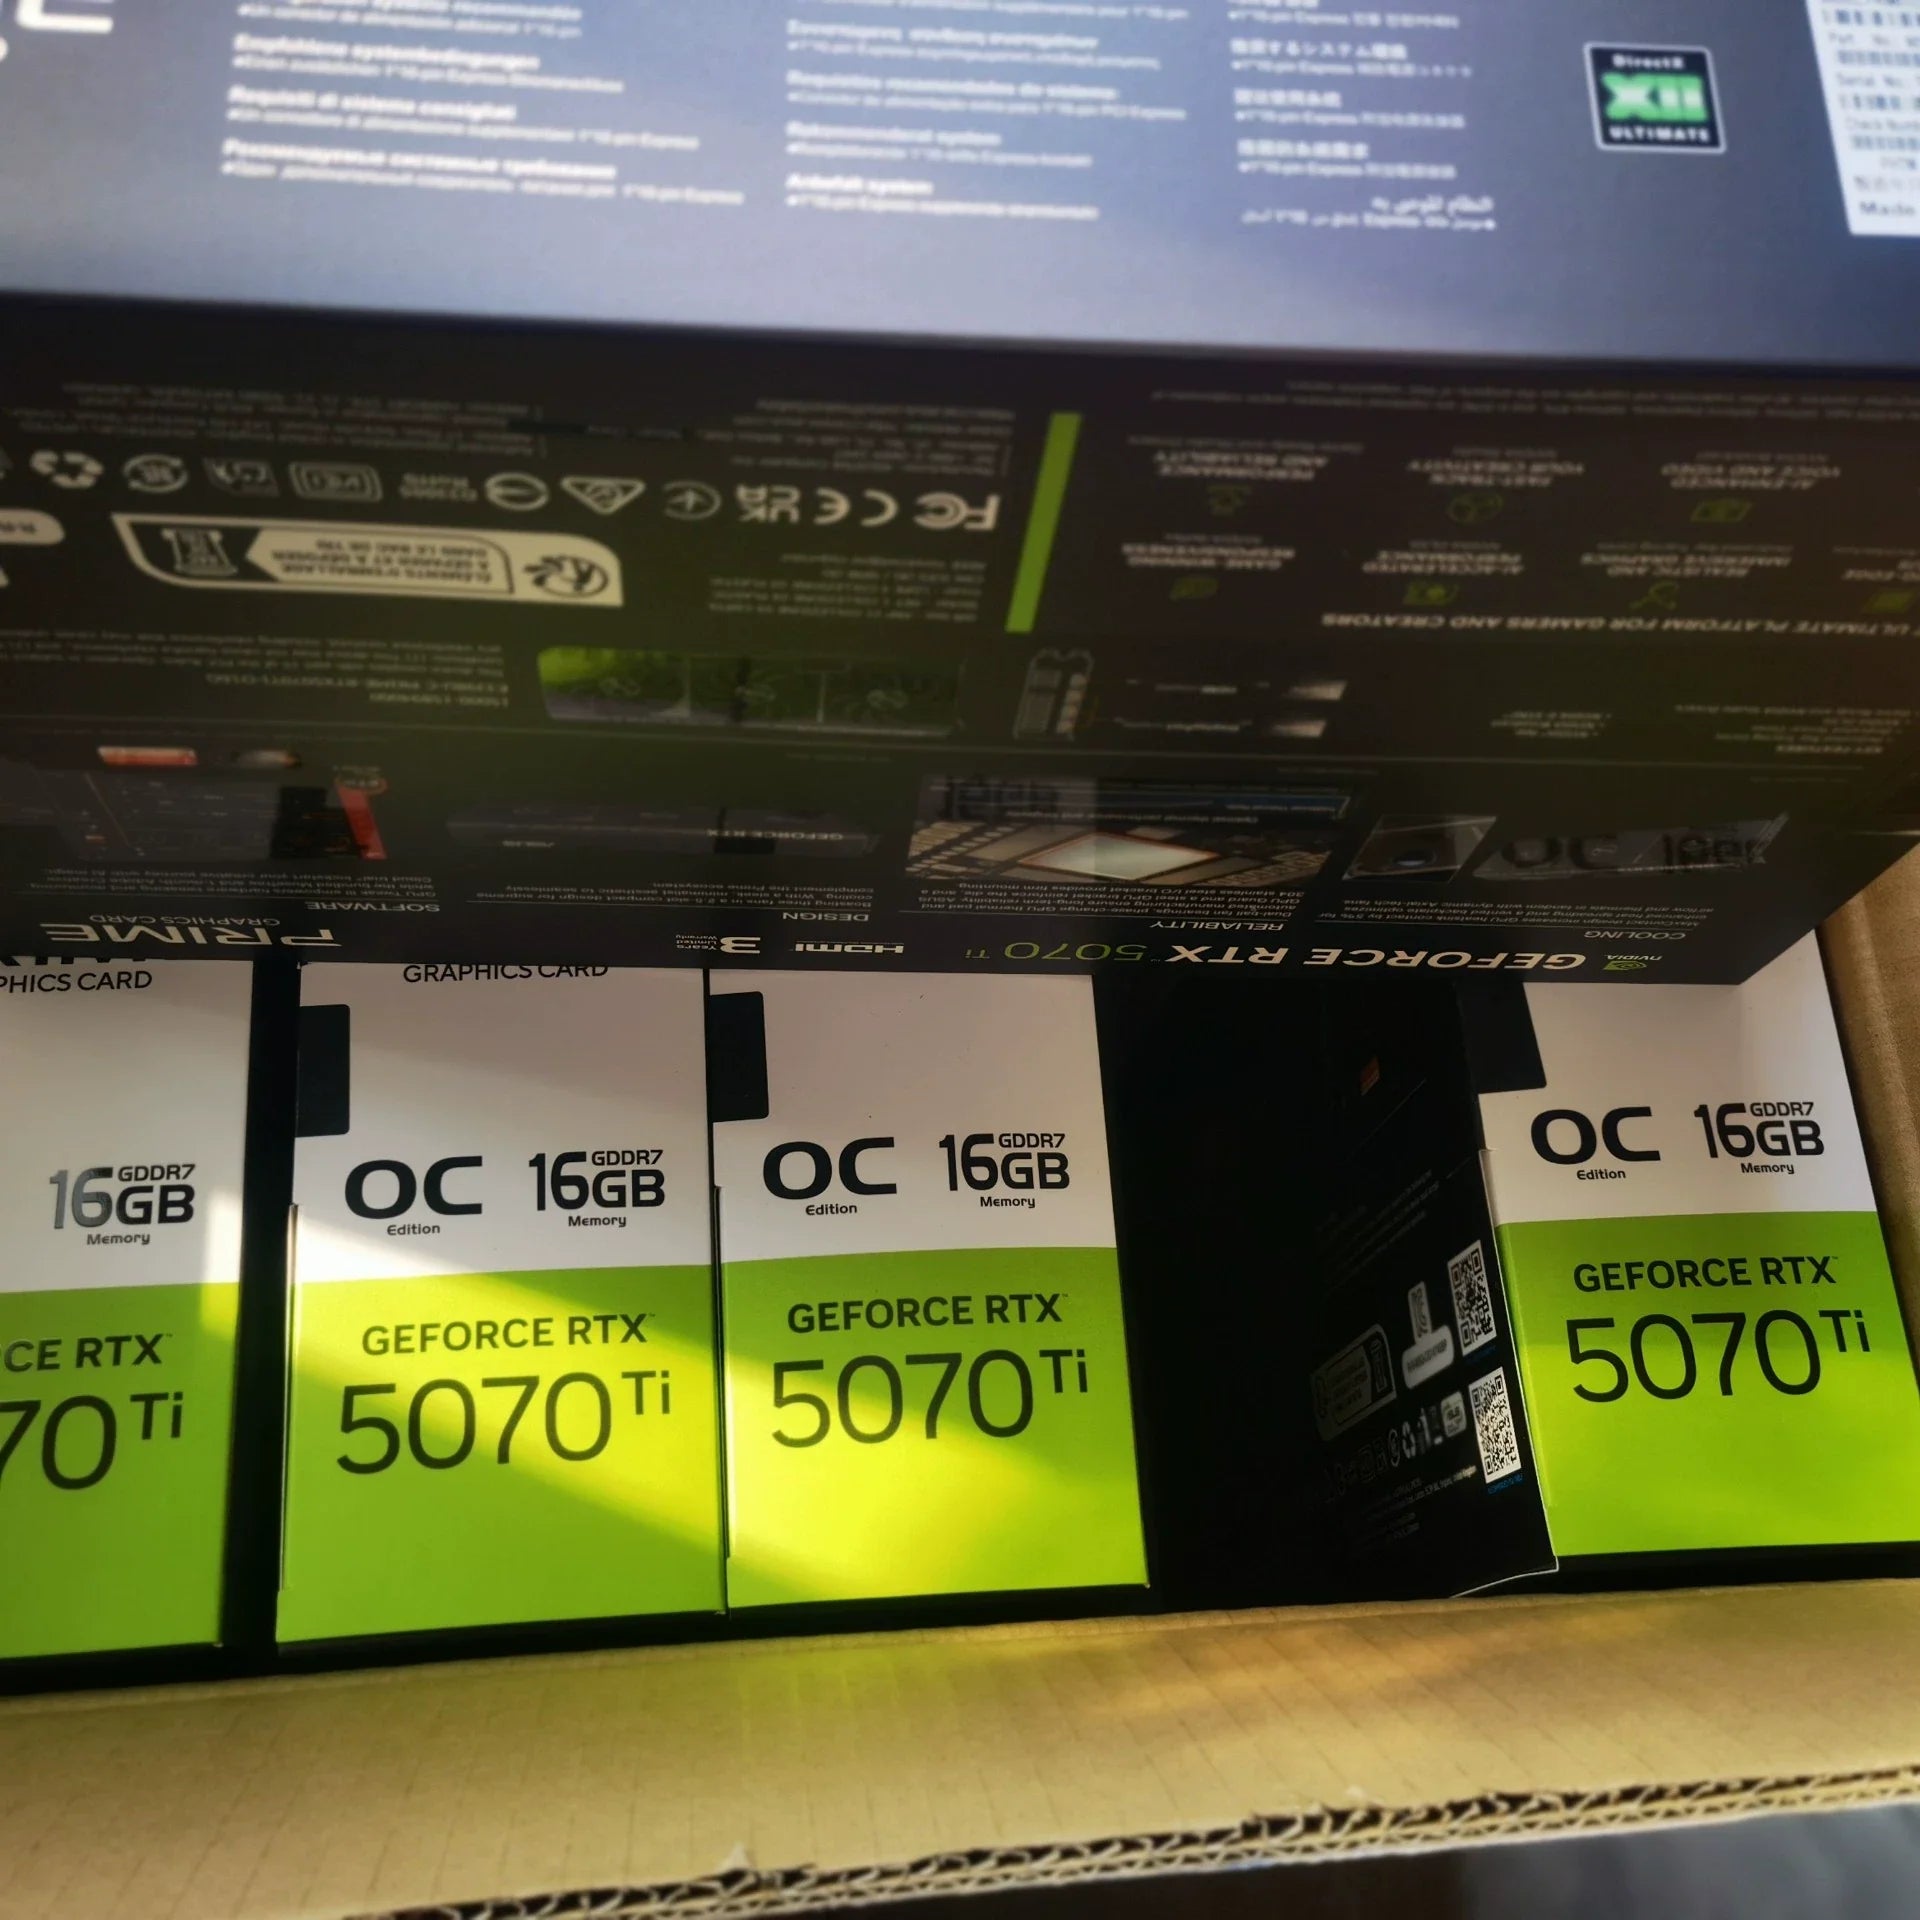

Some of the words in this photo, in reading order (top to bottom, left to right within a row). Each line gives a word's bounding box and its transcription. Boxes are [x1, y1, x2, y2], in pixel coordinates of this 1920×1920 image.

[1609, 126, 1709, 142] ULTIMATE
[1321, 613, 1445, 628] CREATORS
[1450, 615, 1502, 629] AND
[1506, 616, 1606, 631] GAMERS
[1609, 617, 1659, 631] FOR
[1662, 618, 1790, 633] PLATFORM
[1793, 621, 1910, 635] ULTIMATE
[607, 894, 663, 902] compact
[304, 901, 440, 912] SOFTWARE
[88, 914, 156, 923] CARD
[161, 915, 280, 925] GRAPHICS
[781, 912, 870, 922] DESIGN
[1149, 920, 1284, 931] RELIABILITY
[40, 923, 342, 947] PRIME
[1584, 930, 1686, 940] COOLING
[719, 936, 761, 954] 3
[793, 942, 905, 954] HDMI
[1003, 942, 1147, 961] 5070
[963, 948, 991, 960] Ti
[1164, 944, 1289, 964] RTX
[1302, 947, 1586, 970] GEFORCE
[77, 970, 153, 991] CARD
[401, 964, 531, 982] GRAPHICS
[1749, 1101, 1815, 1117] GDDR7
[998, 1132, 1066, 1149] GDDR7
[1530, 1106, 1661, 1165] OC
[591, 1149, 664, 1166] GDDR7
[117, 1164, 195, 1182] GDDR7
[762, 1136, 898, 1200] OC
[1576, 1168, 1626, 1180] Edition
[1740, 1162, 1795, 1175] Memory
[344, 1155, 483, 1219] OC
[805, 1202, 858, 1216] Edition
[980, 1196, 1036, 1209] Memory
[387, 1223, 441, 1236] Edition
[568, 1215, 627, 1228] Memory
[87, 1231, 150, 1246] Memory
[1573, 1257, 1753, 1293] GEFORCE
[1759, 1256, 1837, 1285] RTX
[787, 1295, 974, 1333] GEFORCE
[985, 1293, 1063, 1324] RTX
[361, 1317, 554, 1356] GEFORCE
[568, 1313, 648, 1345] RTX
[0, 1338, 62, 1372] CE
[75, 1333, 164, 1369] RTX
[1565, 1310, 1821, 1403] 5070
[1818, 1310, 1871, 1353] Ti
[771, 1349, 1034, 1448] 5070
[1039, 1348, 1088, 1394] Ti
[130, 1391, 184, 1440] Ti
[336, 1371, 612, 1475] 5070
[620, 1370, 670, 1415] Ti
